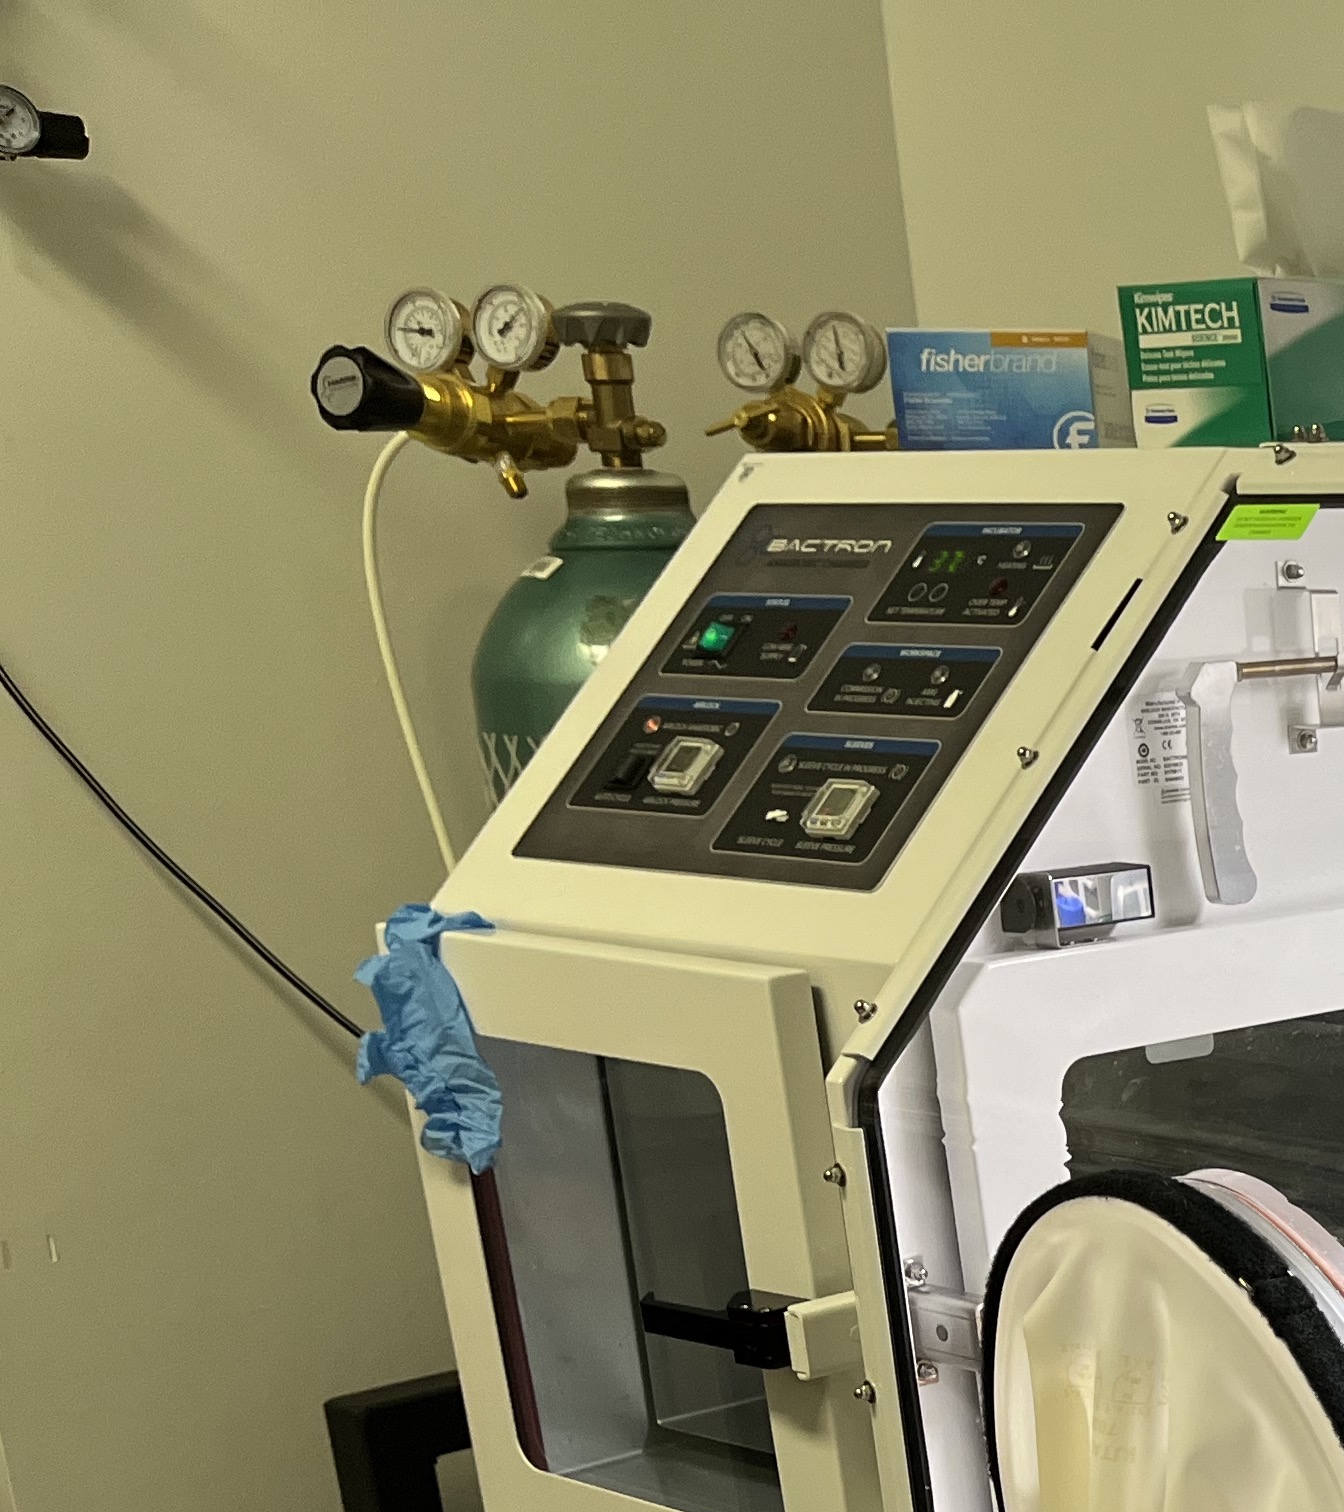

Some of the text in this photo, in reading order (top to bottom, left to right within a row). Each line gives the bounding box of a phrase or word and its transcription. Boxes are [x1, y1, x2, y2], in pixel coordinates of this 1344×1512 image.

[1135, 301, 1240, 333] KIMTECH
[920, 347, 1058, 373] fisherbrand
[766, 538, 893, 555] BACTRON
